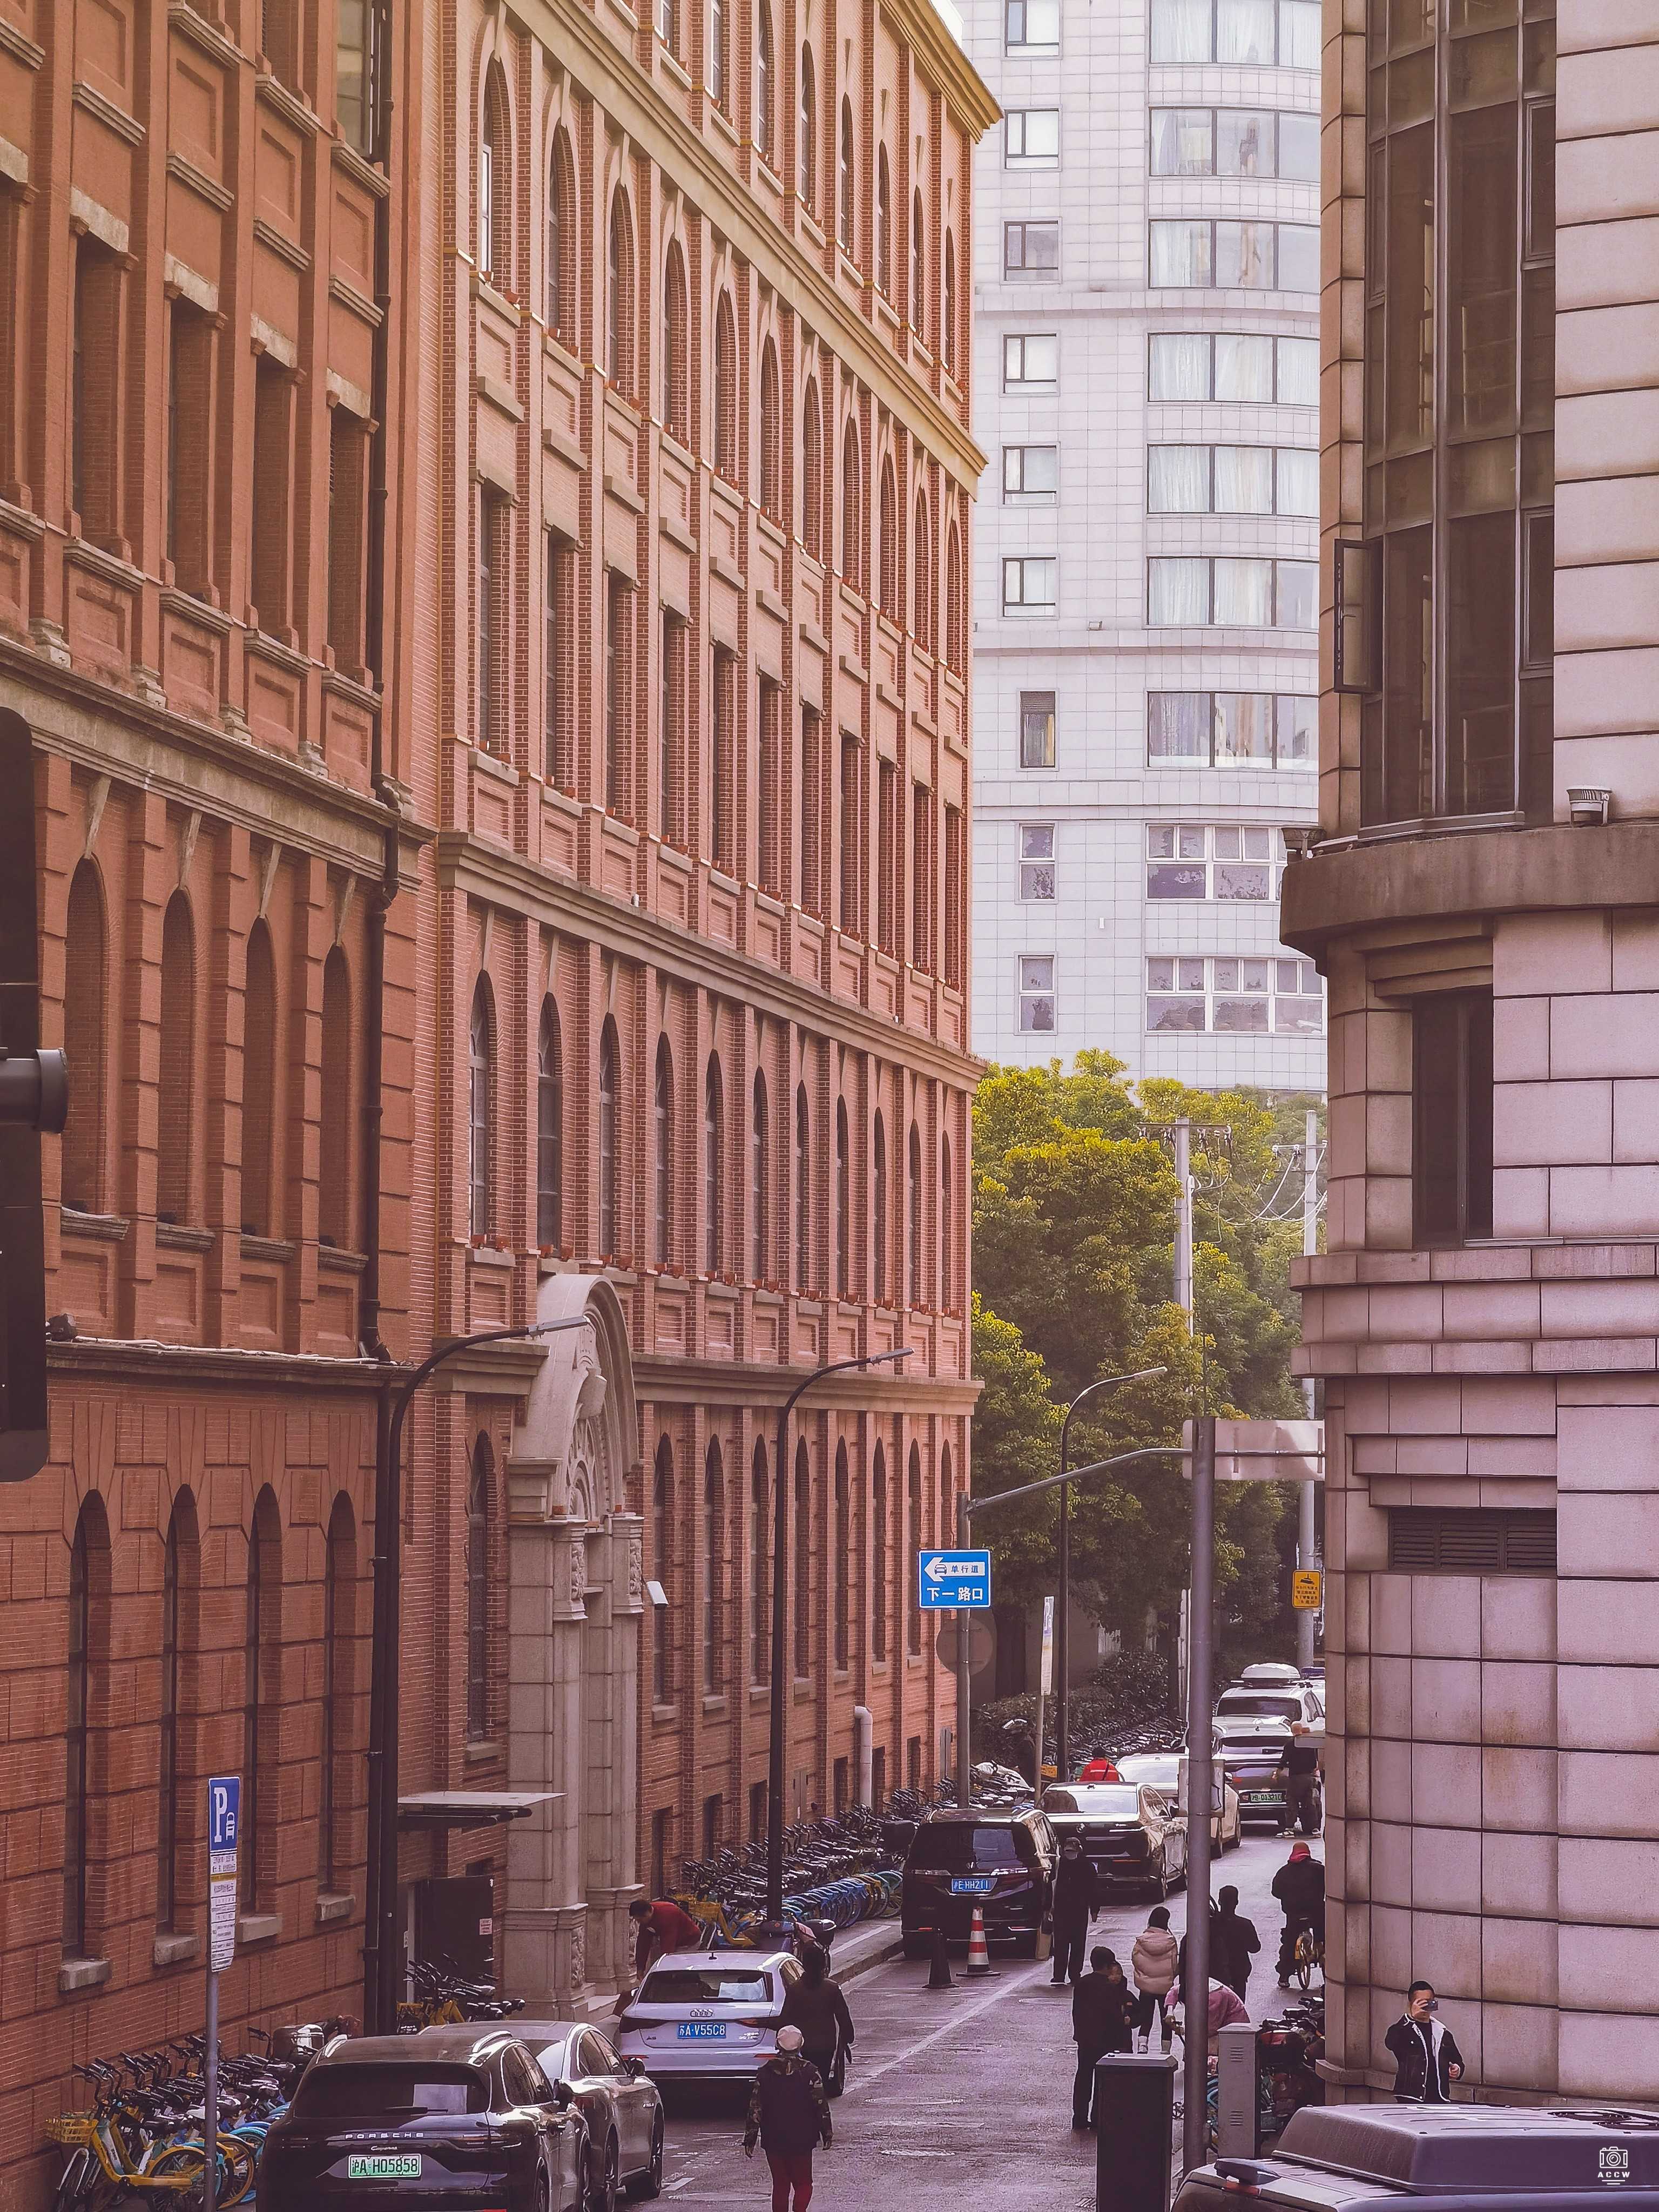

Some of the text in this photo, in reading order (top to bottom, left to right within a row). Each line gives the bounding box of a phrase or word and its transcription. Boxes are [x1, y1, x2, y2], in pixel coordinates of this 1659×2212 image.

[952, 1565, 979, 1573] 单行道
[927, 1587, 983, 1601] 下一路口
[214, 1787, 227, 1843] P
